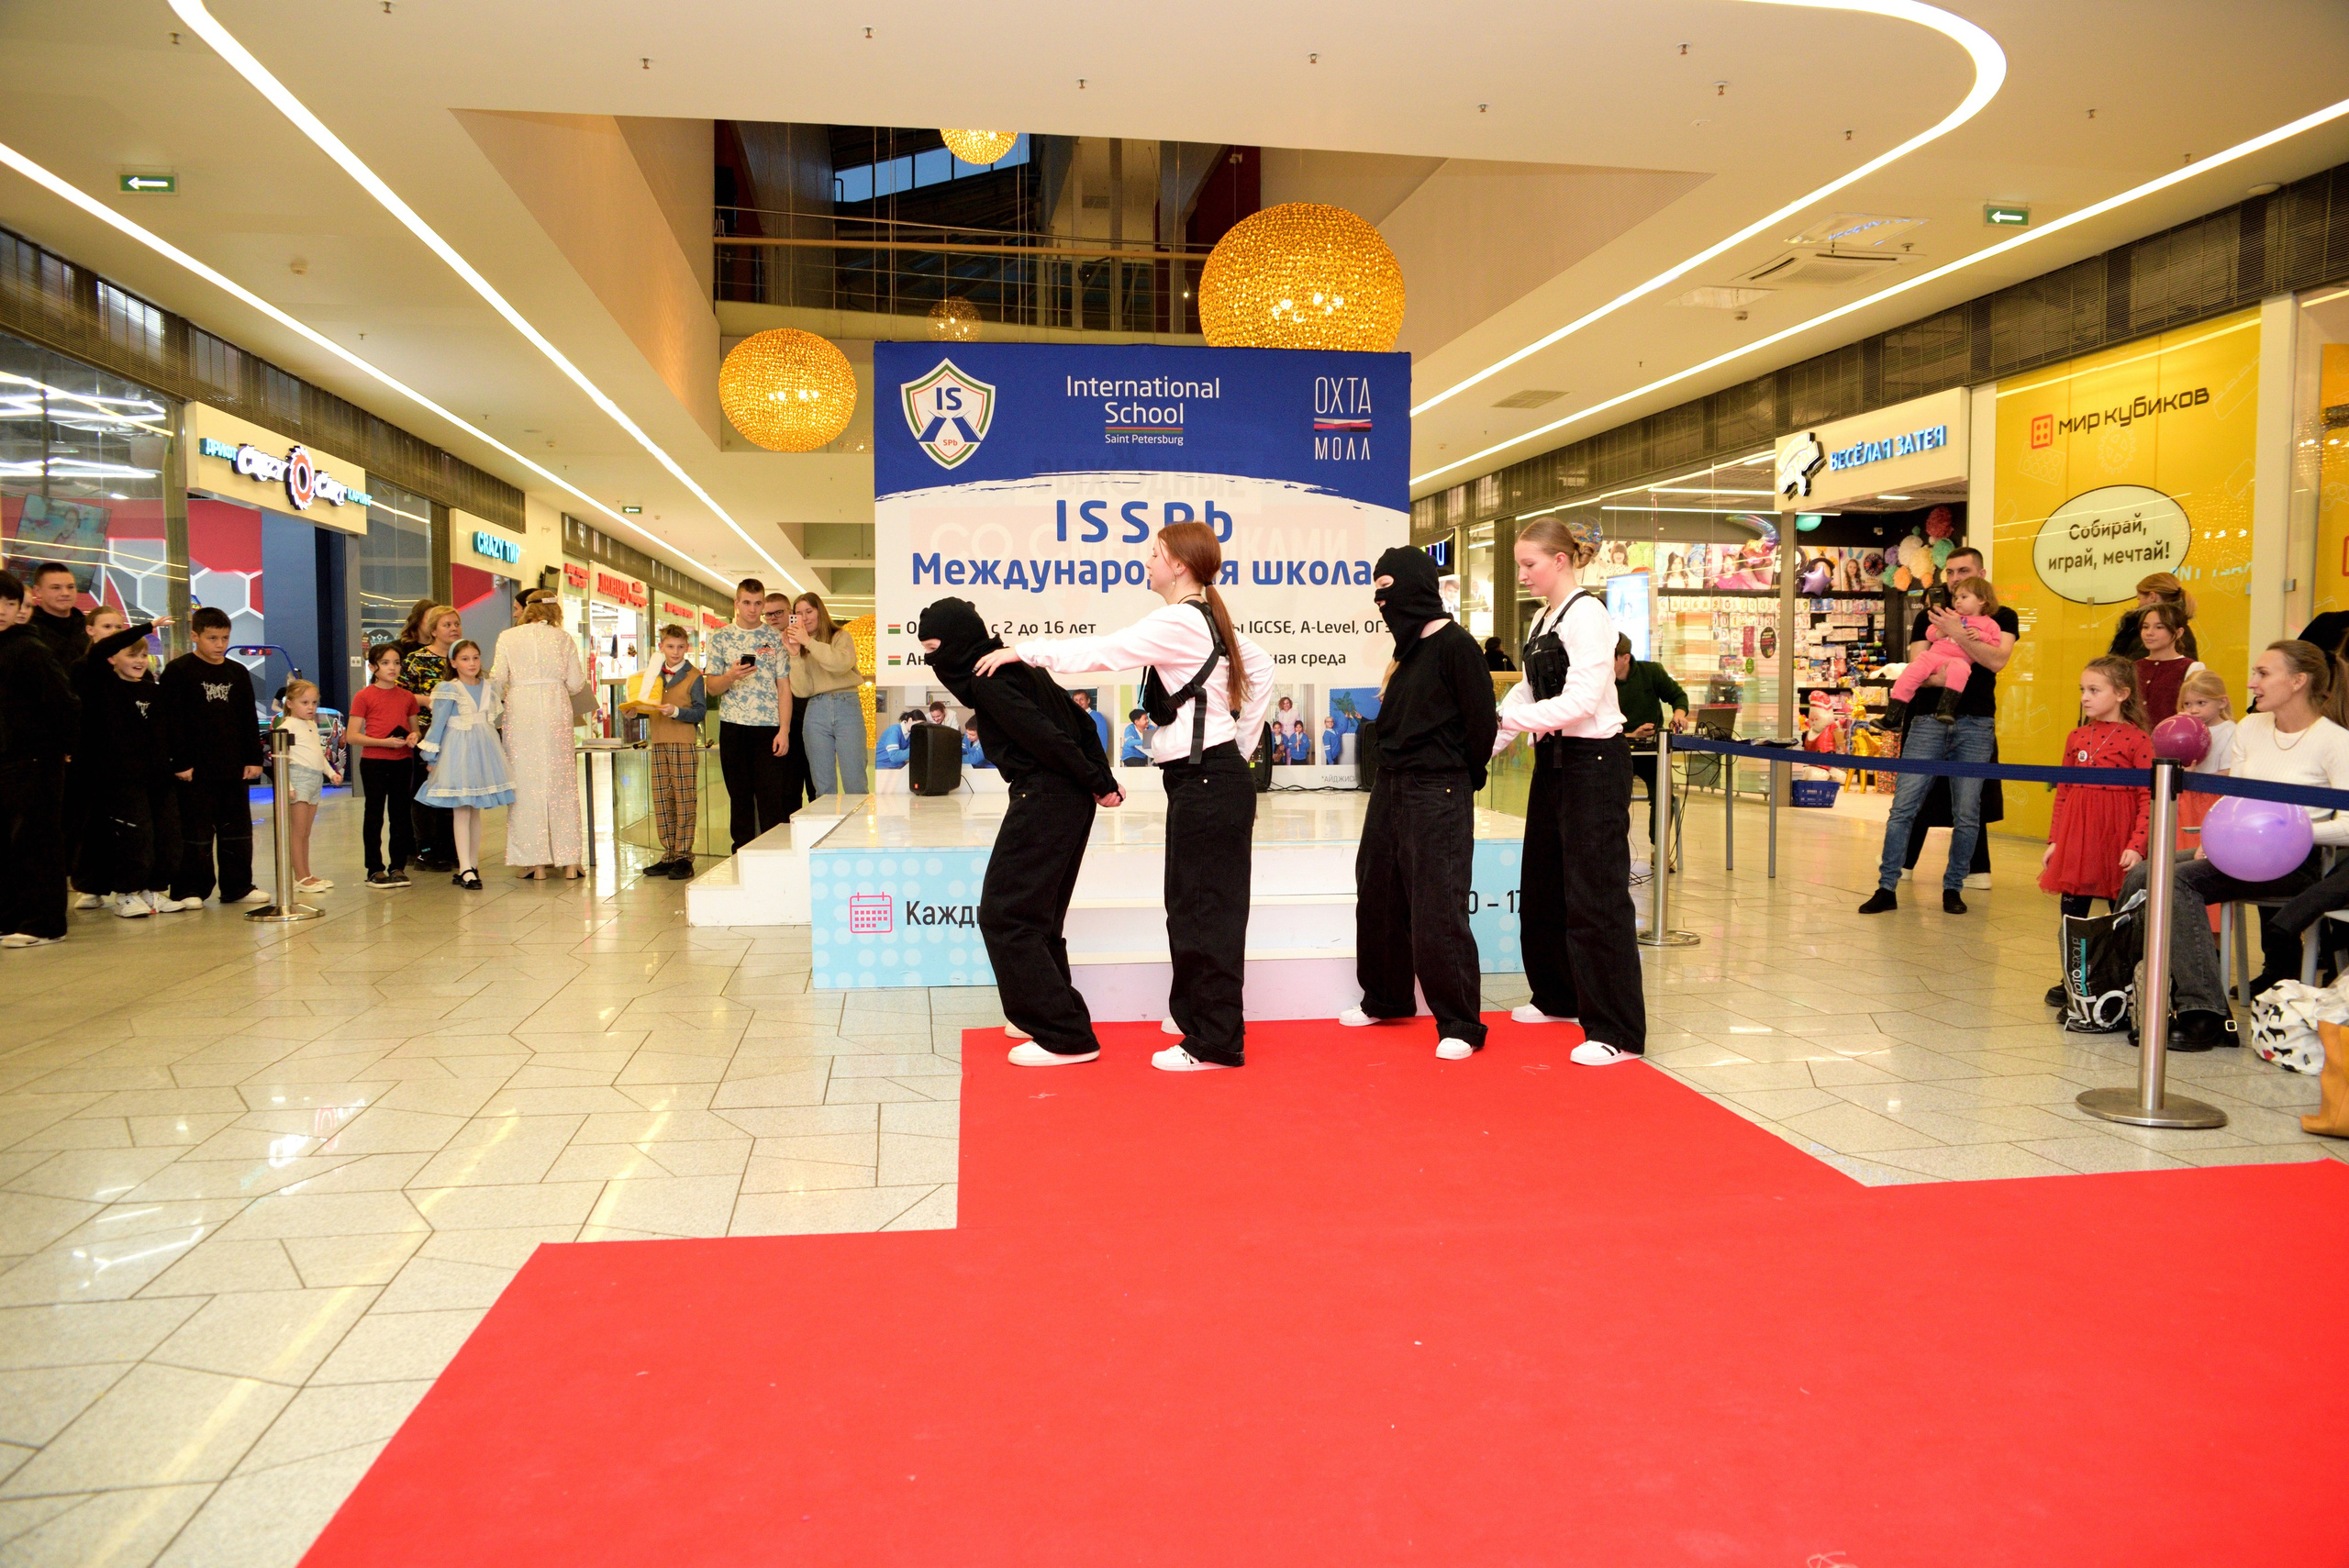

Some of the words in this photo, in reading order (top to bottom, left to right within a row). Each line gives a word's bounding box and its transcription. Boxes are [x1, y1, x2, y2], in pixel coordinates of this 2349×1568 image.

[1067, 375, 1219, 398] International
[1315, 376, 1372, 414] ОХТА
[936, 387, 963, 411] IS
[1105, 401, 1184, 424] School
[205, 438, 238, 461] ДРИФТ
[1105, 434, 1130, 444] Saint
[1131, 434, 1184, 446] Petersburg
[1315, 437, 1371, 461] МОЛЛ
[1829, 439, 1893, 471] ВЕСЁЛАЯ
[1895, 425, 1946, 456] ЗАТЕЯ
[2069, 513, 2147, 540] Собирай,
[476, 530, 505, 560] CRAZY
[506, 540, 520, 564] ТИР
[2048, 548, 2098, 573] играй,
[2103, 540, 2170, 565] мечтай!
[1252, 560, 1372, 585] школа
[991, 623, 999, 635] с
[1004, 621, 1013, 634] 2
[1018, 622, 1039, 636] до
[1044, 621, 1064, 634] 16
[1069, 623, 1097, 634] лет
[1249, 620, 1296, 635] IGCSE,
[1300, 620, 1360, 635] A-Level,
[1301, 653, 1346, 667] среда
[906, 901, 980, 929] Кажд
